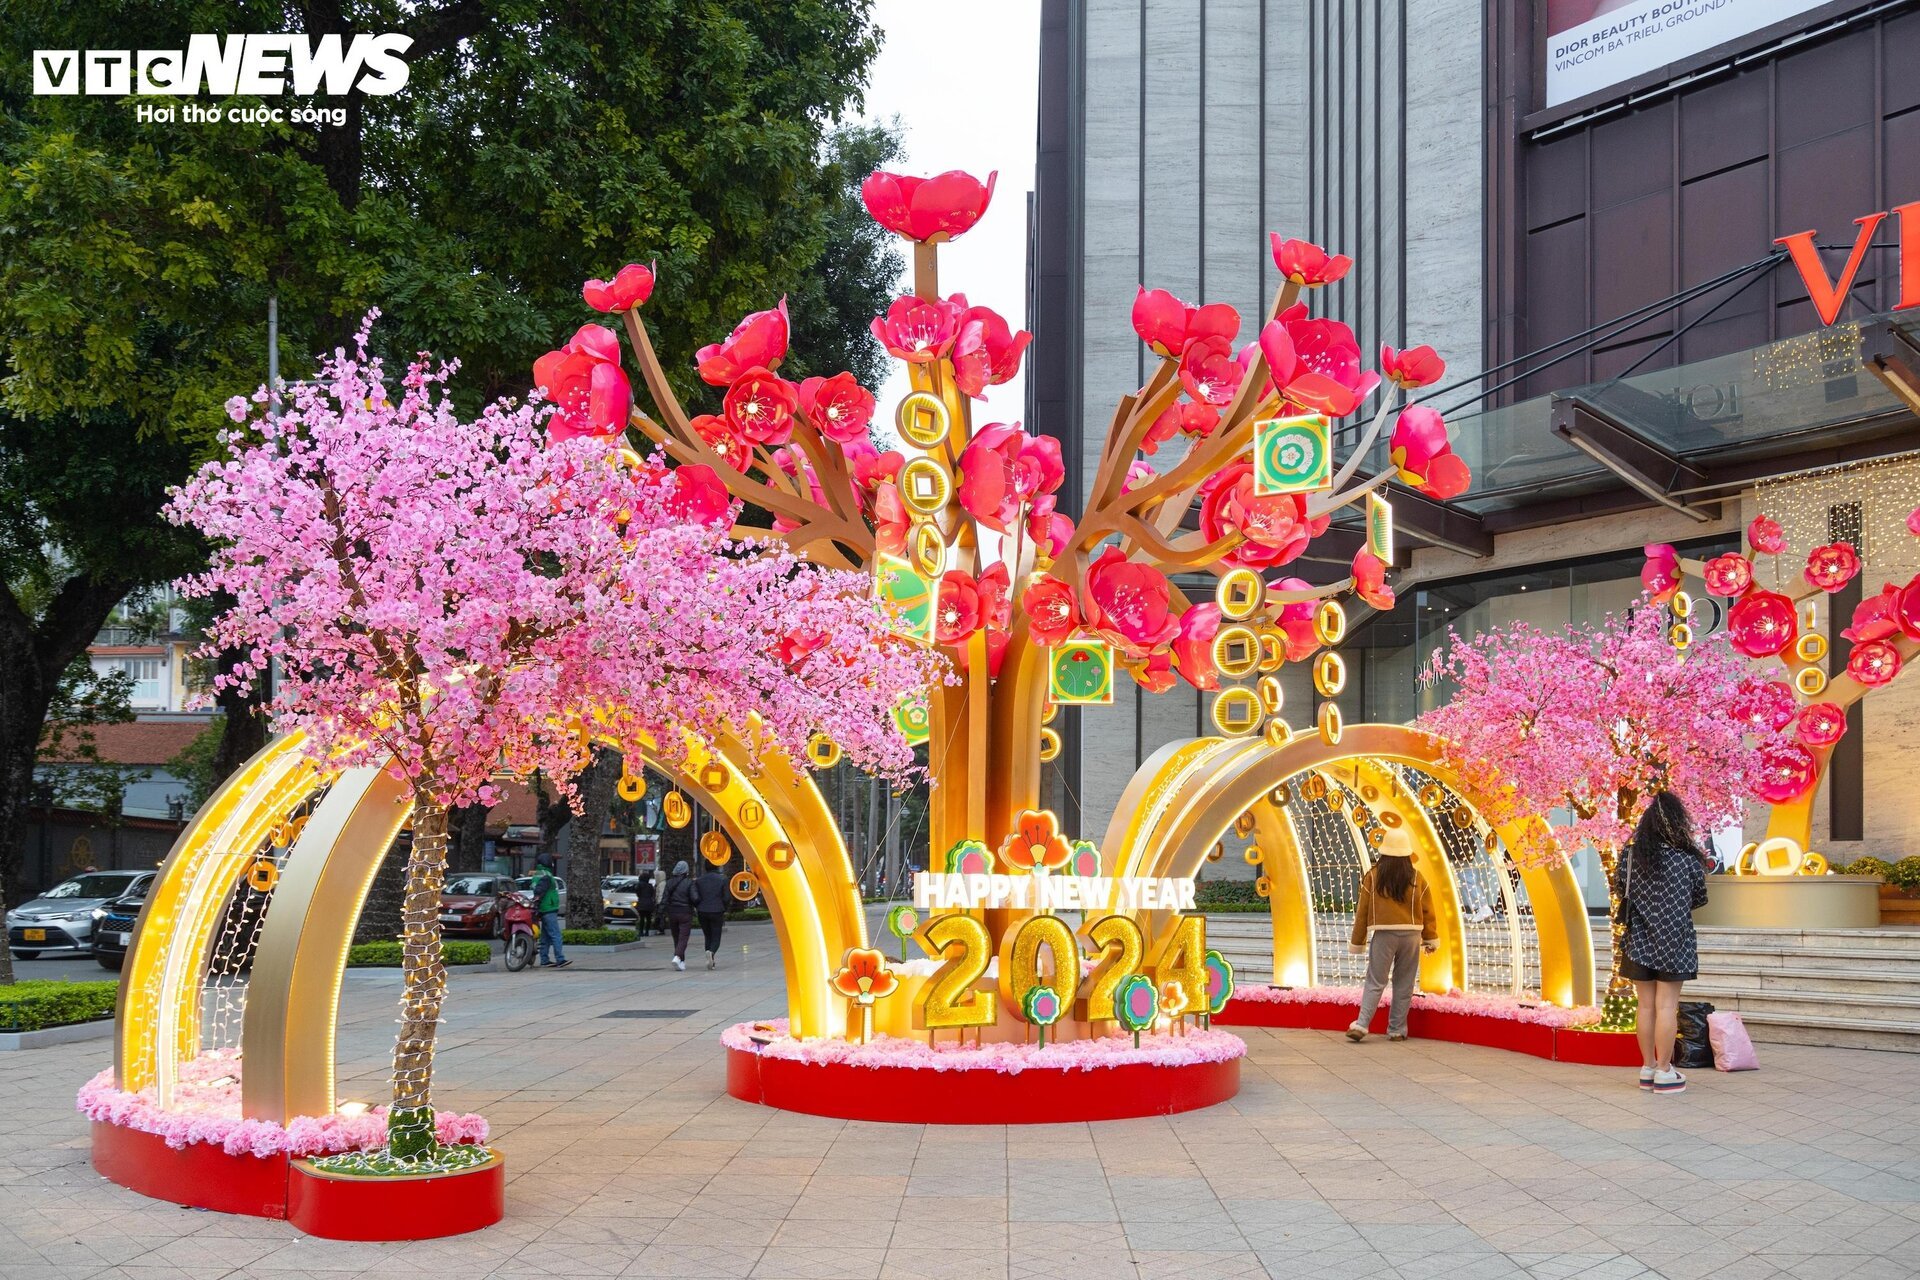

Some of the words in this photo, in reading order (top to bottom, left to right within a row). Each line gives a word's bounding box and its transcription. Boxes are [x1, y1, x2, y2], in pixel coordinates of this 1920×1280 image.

[1555, 38, 1589, 59] DIOR
[1592, 13, 1648, 44] BEAUTY
[1555, 45, 1604, 72] VINCOM
[1607, 38, 1624, 53] BA
[1626, 22, 1663, 44] TRIEU,
[1666, 0, 1726, 28] GROUND
[916, 872, 1031, 909] HAPPY
[1038, 875, 1112, 909] NEW
[1122, 876, 1198, 909] YEAR
[915, 913, 1210, 1029] 2024
